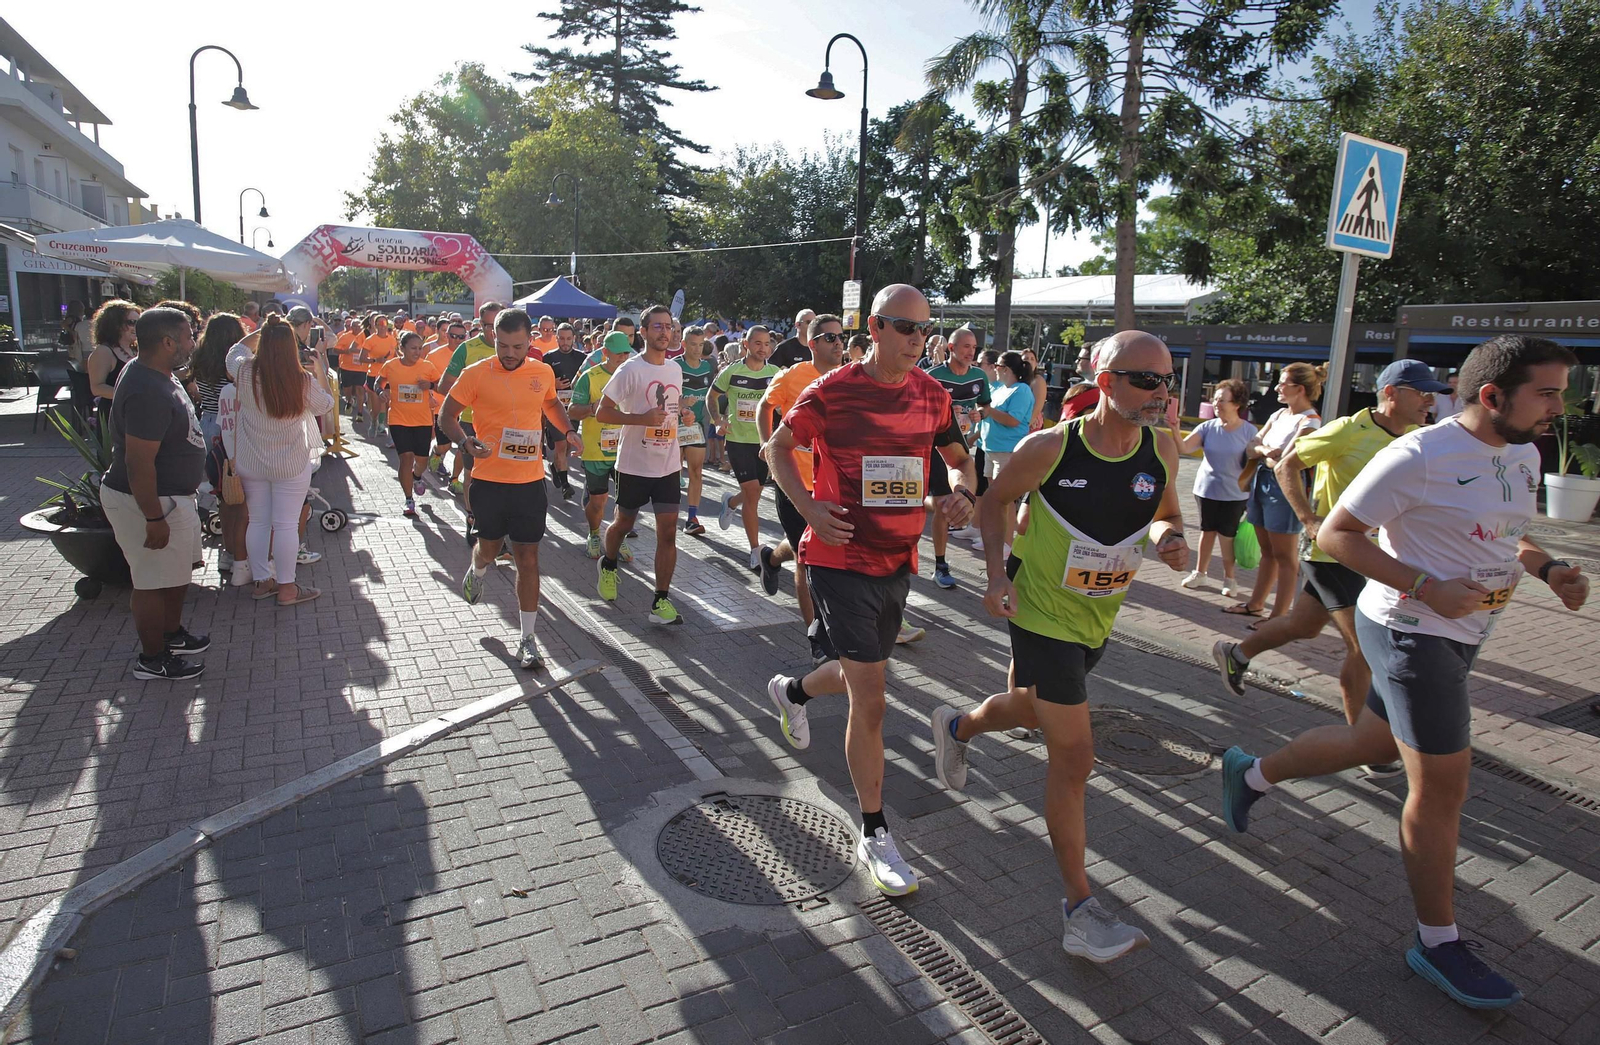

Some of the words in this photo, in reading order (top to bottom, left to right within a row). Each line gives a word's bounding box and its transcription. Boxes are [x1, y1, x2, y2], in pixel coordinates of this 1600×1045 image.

[49, 240, 108, 254] Cruzcampo
[378, 245, 438, 256] SOLIDARIA
[368, 254, 383, 262] DE
[386, 254, 449, 266] PALMONES
[1452, 315, 1600, 328] Restaurante
[1225, 333, 1242, 341] La
[1246, 334, 1308, 342] Mulata
[739, 410, 757, 418] 26
[654, 429, 670, 437] 89
[505, 444, 536, 454] 450
[871, 482, 918, 495] 368
[1078, 571, 1130, 586] 154
